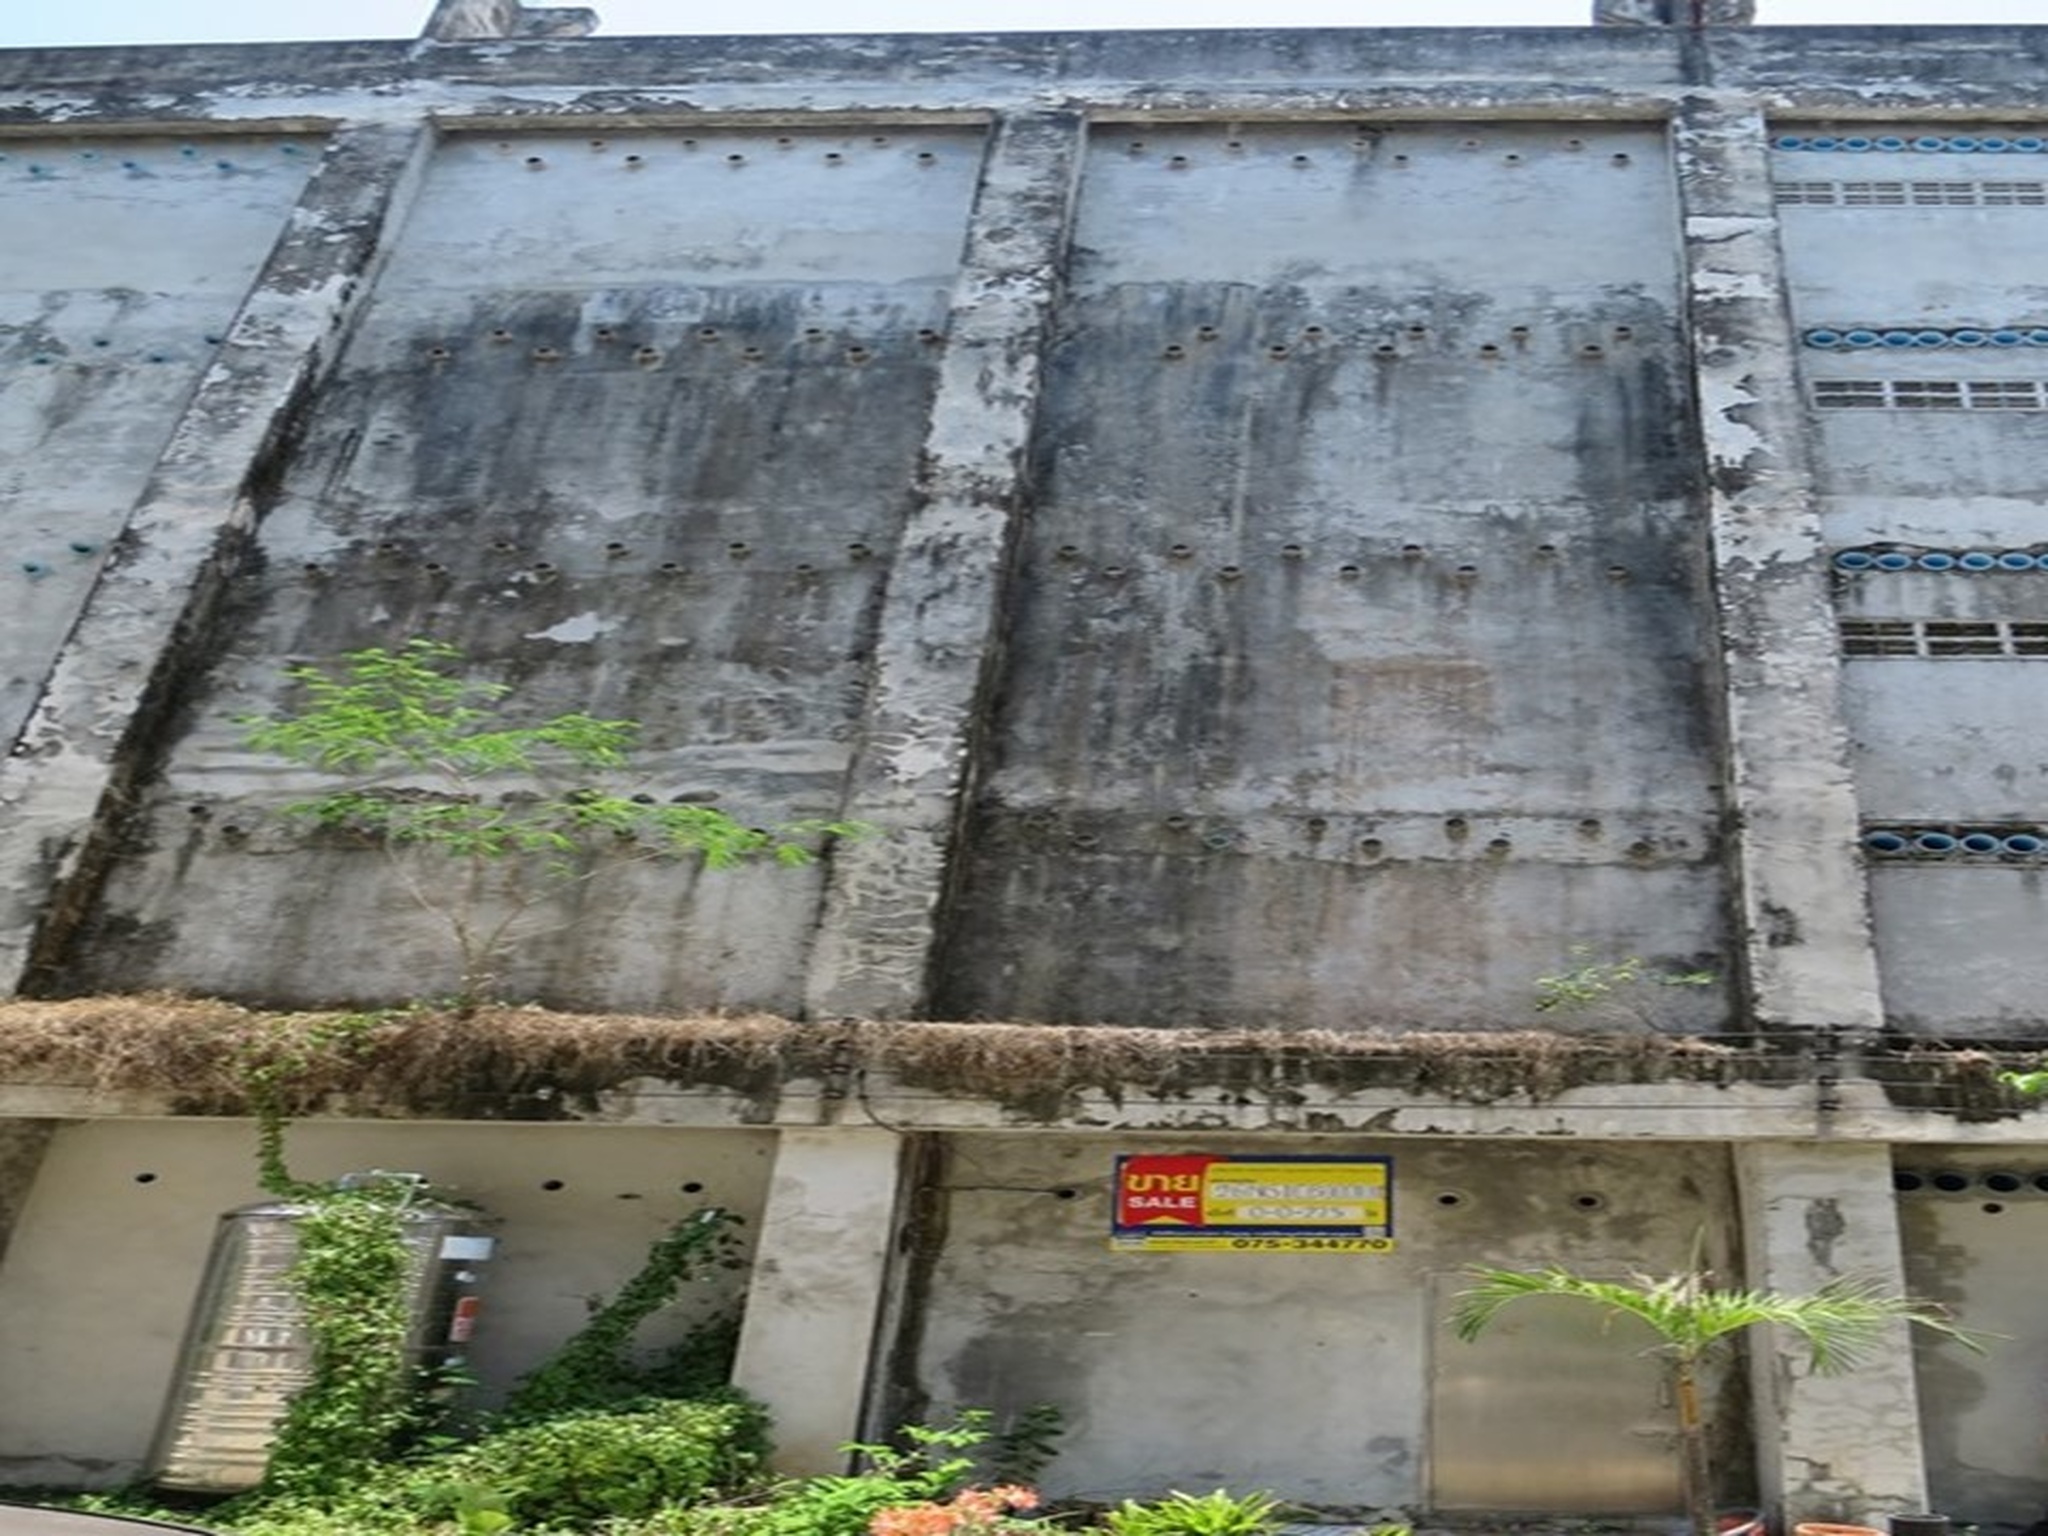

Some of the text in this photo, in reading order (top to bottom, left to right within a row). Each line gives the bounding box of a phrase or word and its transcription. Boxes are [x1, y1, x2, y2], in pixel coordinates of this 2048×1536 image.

[1127, 1174, 1199, 1192] ขาย
[1127, 1197, 1196, 1208] SALE
[1232, 1238, 1388, 1249] 075-344770
